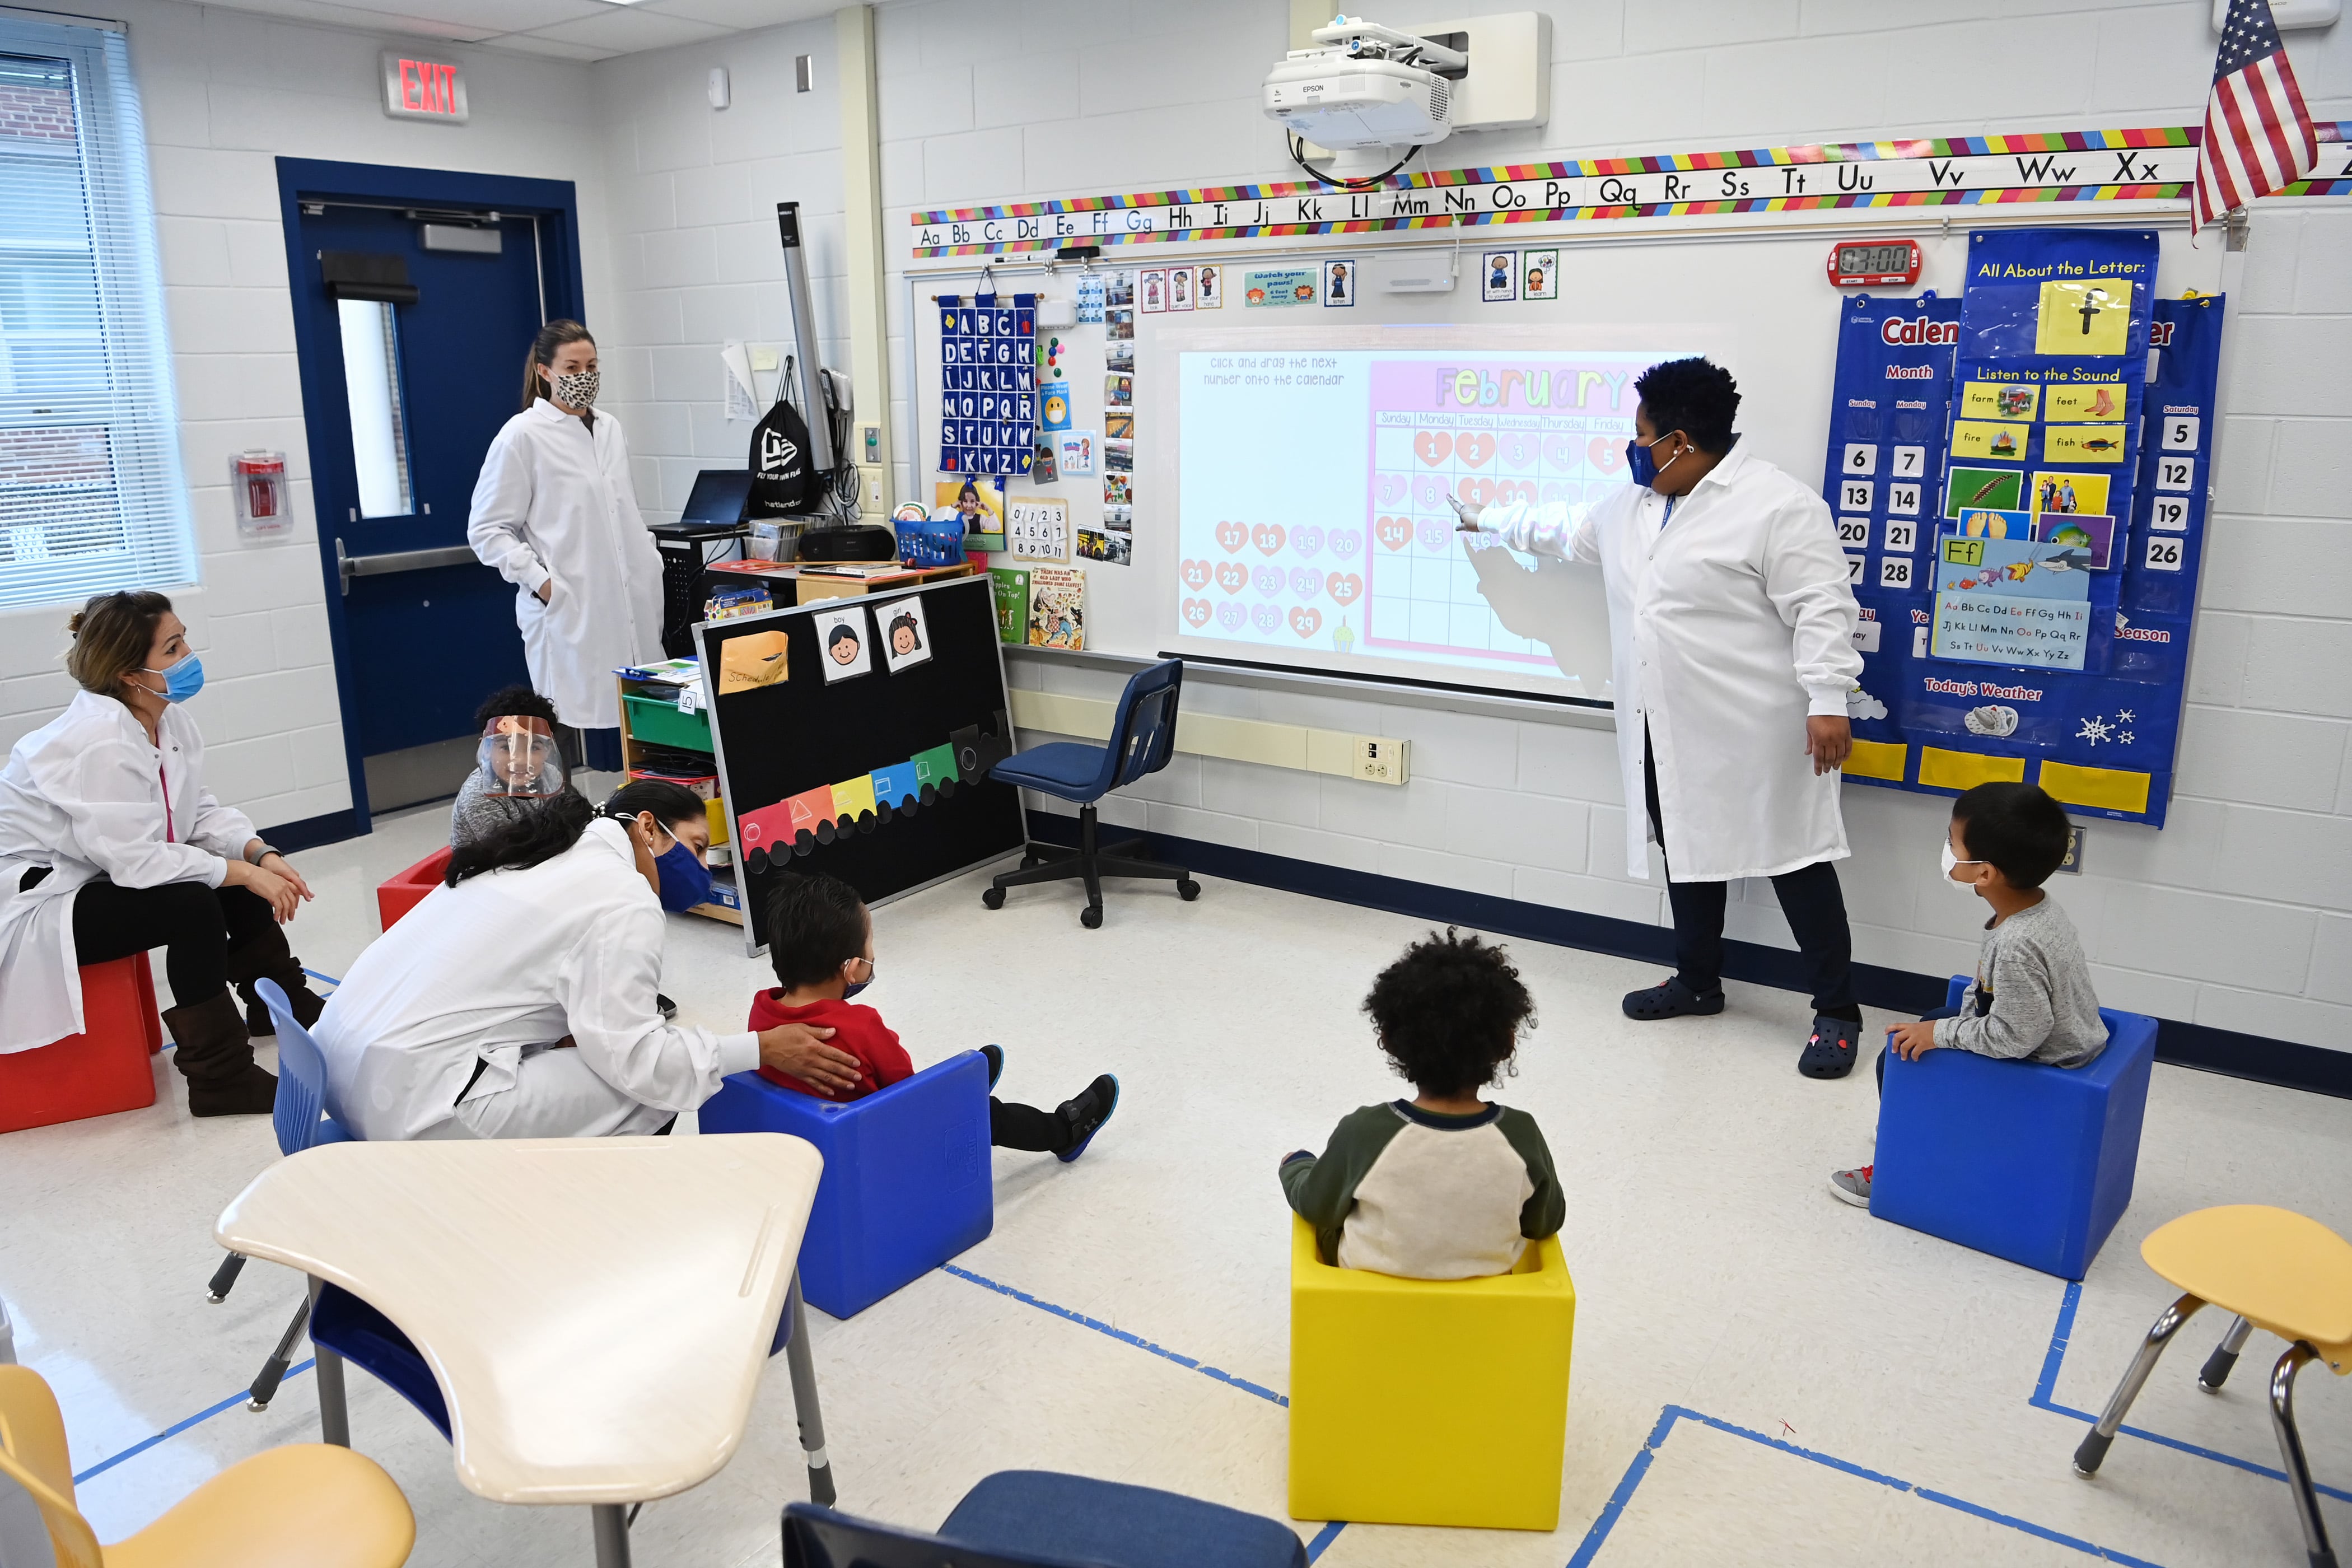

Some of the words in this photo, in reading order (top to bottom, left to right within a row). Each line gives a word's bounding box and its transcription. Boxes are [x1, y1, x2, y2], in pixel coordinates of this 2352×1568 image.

[399, 59, 456, 114] EXIT
[921, 228, 940, 246] Aa
[953, 224, 970, 243] Bb
[984, 222, 1003, 241] Cc
[1018, 218, 1039, 239] Dd
[1057, 215, 1074, 235] Ee
[1093, 212, 1109, 233] Ff
[1127, 209, 1152, 234] Gg
[1169, 207, 1192, 228] Hh
[1213, 204, 1229, 226] Ii
[1253, 201, 1270, 228] Jj
[1297, 198, 1323, 221] Kk
[1352, 195, 1368, 218] Ll
[1393, 191, 1429, 216] Mm
[1445, 189, 1476, 212] Nn
[1492, 184, 1527, 209] Oo
[1546, 181, 1571, 209] Pp
[1599, 178, 1640, 211] Qq
[1665, 174, 1691, 200] Rr
[1721, 171, 1749, 197] Ss
[1781, 168, 1805, 194] Tt
[1838, 164, 1873, 191] Uu
[1929, 159, 1964, 187] Vv
[2016, 155, 2076, 184] Ww
[2112, 151, 2159, 181] Xx
[1978, 263, 2000, 277] All
[2004, 262, 2053, 278] About
[2057, 262, 2083, 275] the
[2089, 260, 2145, 275] Letter:
[1267, 279, 1293, 288] paws!
[2078, 287, 2106, 335] f
[1211, 358, 1233, 368] Click
[1238, 357, 1256, 368] and
[1261, 357, 1285, 368] drag
[1289, 358, 1307, 368] the
[1312, 358, 1337, 368] next
[1204, 374, 1240, 385] number
[1245, 375, 1269, 385] onto
[1274, 375, 1291, 385] the
[1296, 374, 1344, 385] calendar
[1886, 364, 1933, 379] Month
[1977, 368, 2020, 381] Listen
[2024, 369, 2040, 381] to
[2044, 368, 2069, 381] the
[2073, 368, 2120, 382] Sound
[1436, 368, 1628, 410] February
[1849, 399, 1876, 409] Sunday
[1896, 400, 1926, 410] Monday
[1972, 394, 1994, 404] farm
[2056, 396, 2078, 406] feet
[2163, 404, 2198, 414] Saturday
[1382, 413, 1411, 425] Sunday
[1420, 413, 1454, 426] Monday
[1458, 415, 1494, 428] Tuesday
[1498, 416, 1540, 430] Wednesday
[1542, 417, 1585, 430] Thursday
[1594, 418, 1623, 431] Friday
[1964, 432, 1981, 442] fire
[2174, 424, 2188, 442] 5
[2056, 437, 2075, 447] fish
[1853, 451, 1866, 467] 6
[1903, 454, 1916, 470] 7
[790, 468, 801, 478] FLAG
[2164, 464, 2187, 483] 12
[1847, 488, 1868, 505] 13
[1894, 491, 1915, 507] 14
[1014, 510, 1020, 519] 0
[1030, 512, 1034, 521] 1
[1042, 511, 1048, 520] 2
[1056, 512, 1061, 521] 3
[2158, 504, 2181, 523] 19
[1015, 526, 1020, 535] 4
[1029, 527, 1035, 536] 5
[1042, 528, 1048, 538] 6
[1056, 528, 1061, 537] 7
[1225, 531, 1240, 545] 17
[1260, 534, 1276, 548] 18
[1384, 526, 1404, 543] 14
[1840, 524, 1866, 540] 20
[1891, 528, 1911, 544] 21
[1018, 544, 1024, 553] 8
[1030, 545, 1035, 554] 9
[1042, 544, 1051, 554] 10
[1054, 547, 1061, 557] 11
[1948, 542, 1978, 562] Ff
[2150, 544, 2177, 563] 26
[1884, 564, 1907, 582] 28
[1188, 568, 1204, 582] 21
[1222, 571, 1239, 586] 22
[1334, 582, 1352, 597] 25
[893, 607, 902, 616] girl
[1189, 607, 1205, 620] 26
[1297, 616, 1314, 631] 29
[1945, 602, 1957, 610] Aa
[1962, 603, 1973, 612] Bb
[1977, 605, 1990, 613] Cc
[1994, 606, 2006, 615] Dd
[2010, 607, 2022, 616] Ee
[2038, 610, 2054, 620] Gg
[2058, 611, 2071, 620] Hh
[2075, 612, 2083, 620] Ii
[834, 616, 845, 624] boy
[2115, 626, 2170, 642] Season
[1925, 678, 1977, 696] Today's
[1981, 683, 2042, 701] Weather
[682, 696, 692, 708] 15
